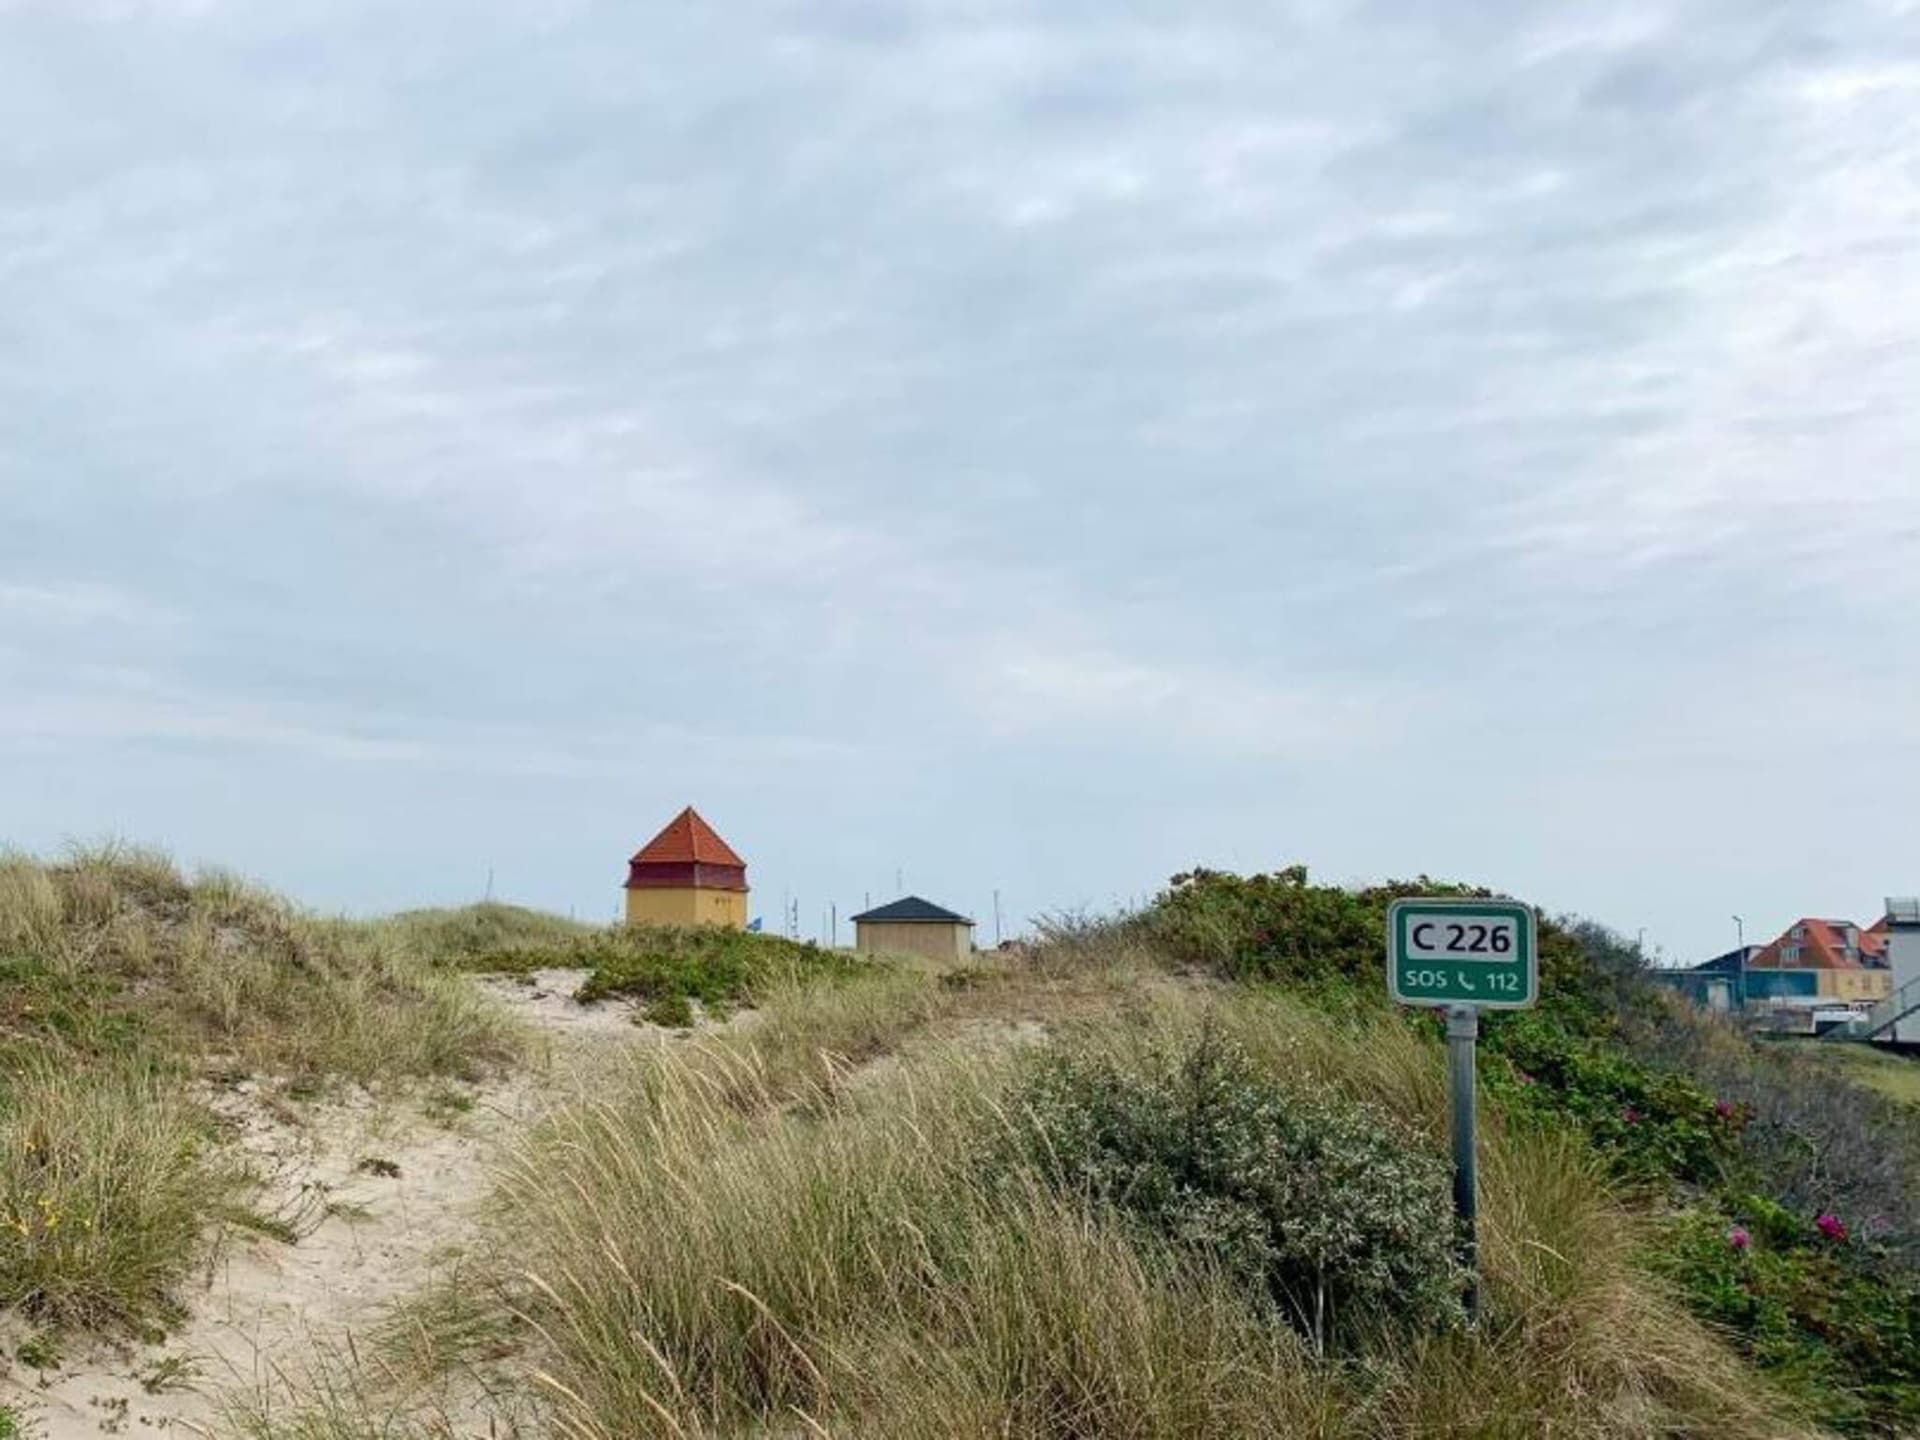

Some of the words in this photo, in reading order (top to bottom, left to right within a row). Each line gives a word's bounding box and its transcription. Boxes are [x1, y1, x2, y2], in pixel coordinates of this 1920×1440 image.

[1412, 923, 1435, 950] C
[1446, 924, 1511, 953] 226
[1405, 970, 1448, 988] SOS
[1486, 973, 1519, 991] 112
